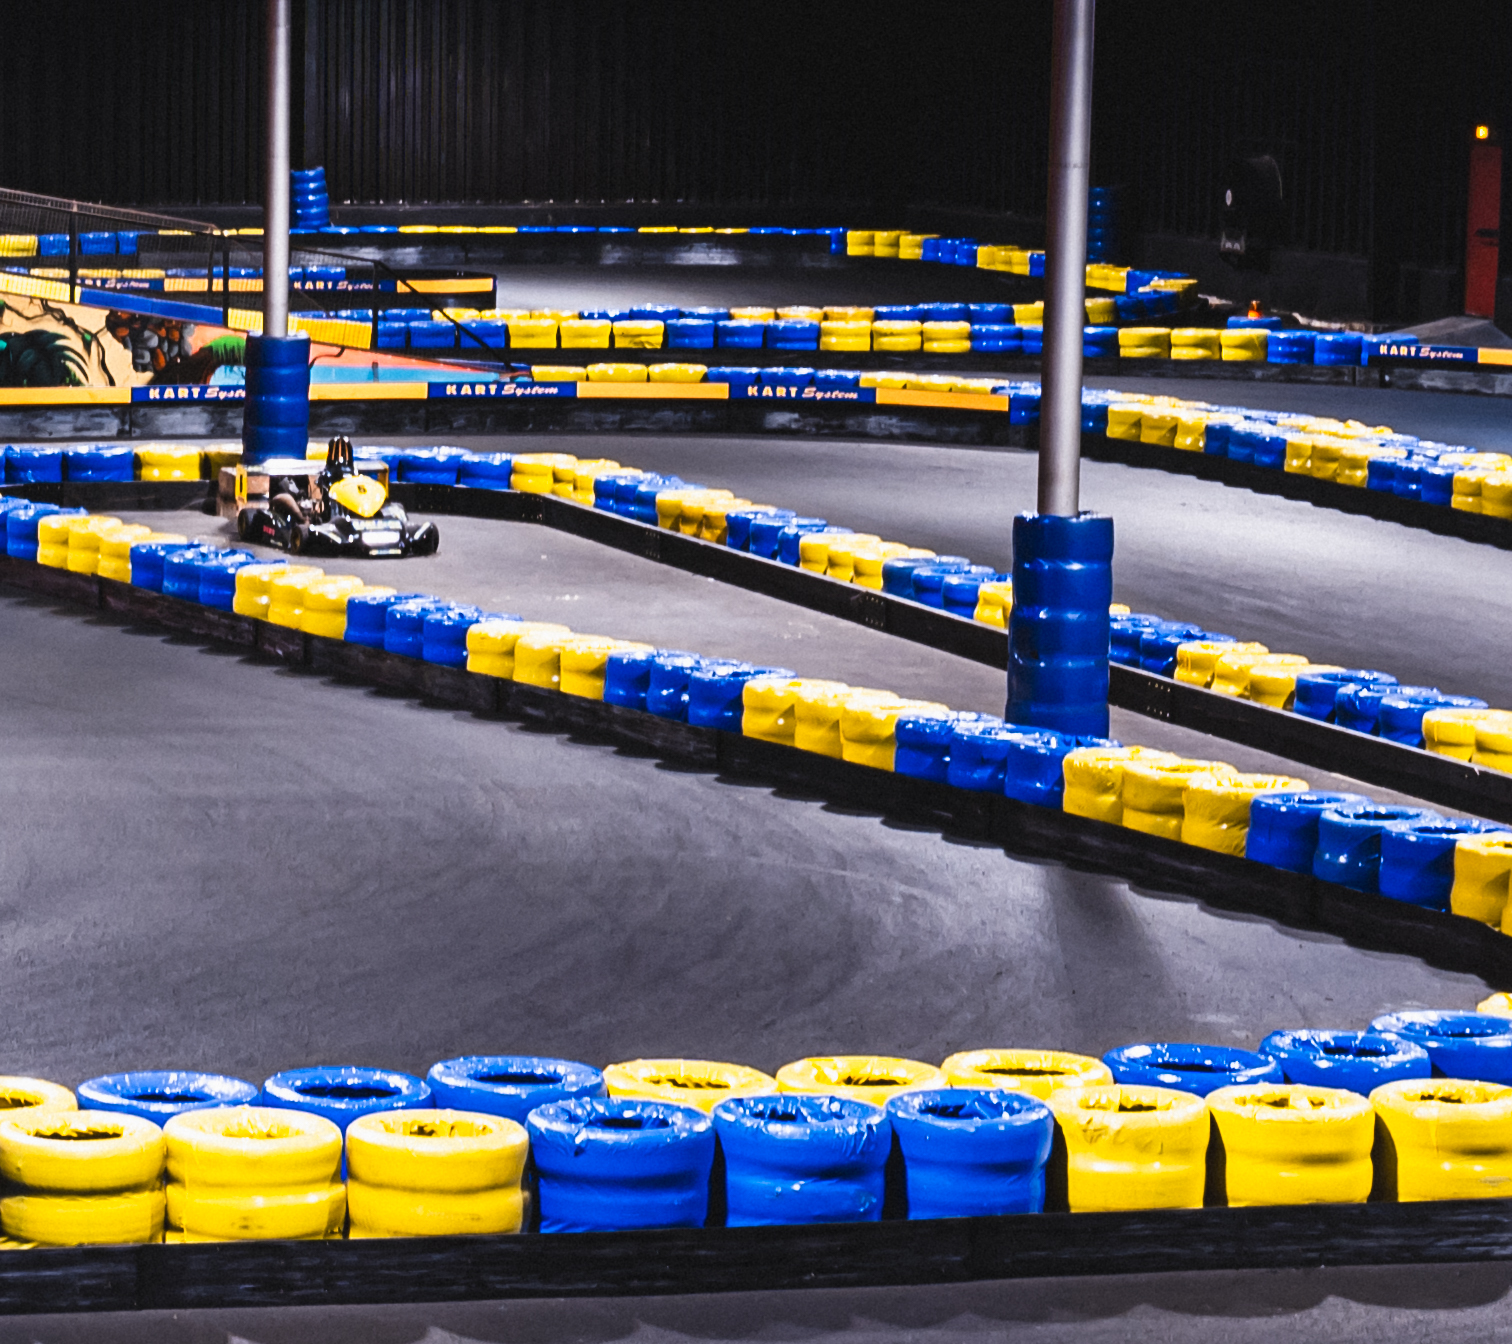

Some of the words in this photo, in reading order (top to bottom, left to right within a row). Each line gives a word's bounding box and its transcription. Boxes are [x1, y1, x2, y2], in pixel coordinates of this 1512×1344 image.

[1379, 344, 1417, 357] KART
[1419, 346, 1464, 360] System
[148, 386, 201, 400] KART
[445, 383, 498, 396] KART
[501, 383, 559, 397] System
[747, 385, 798, 398] KART
[802, 386, 859, 401] System
